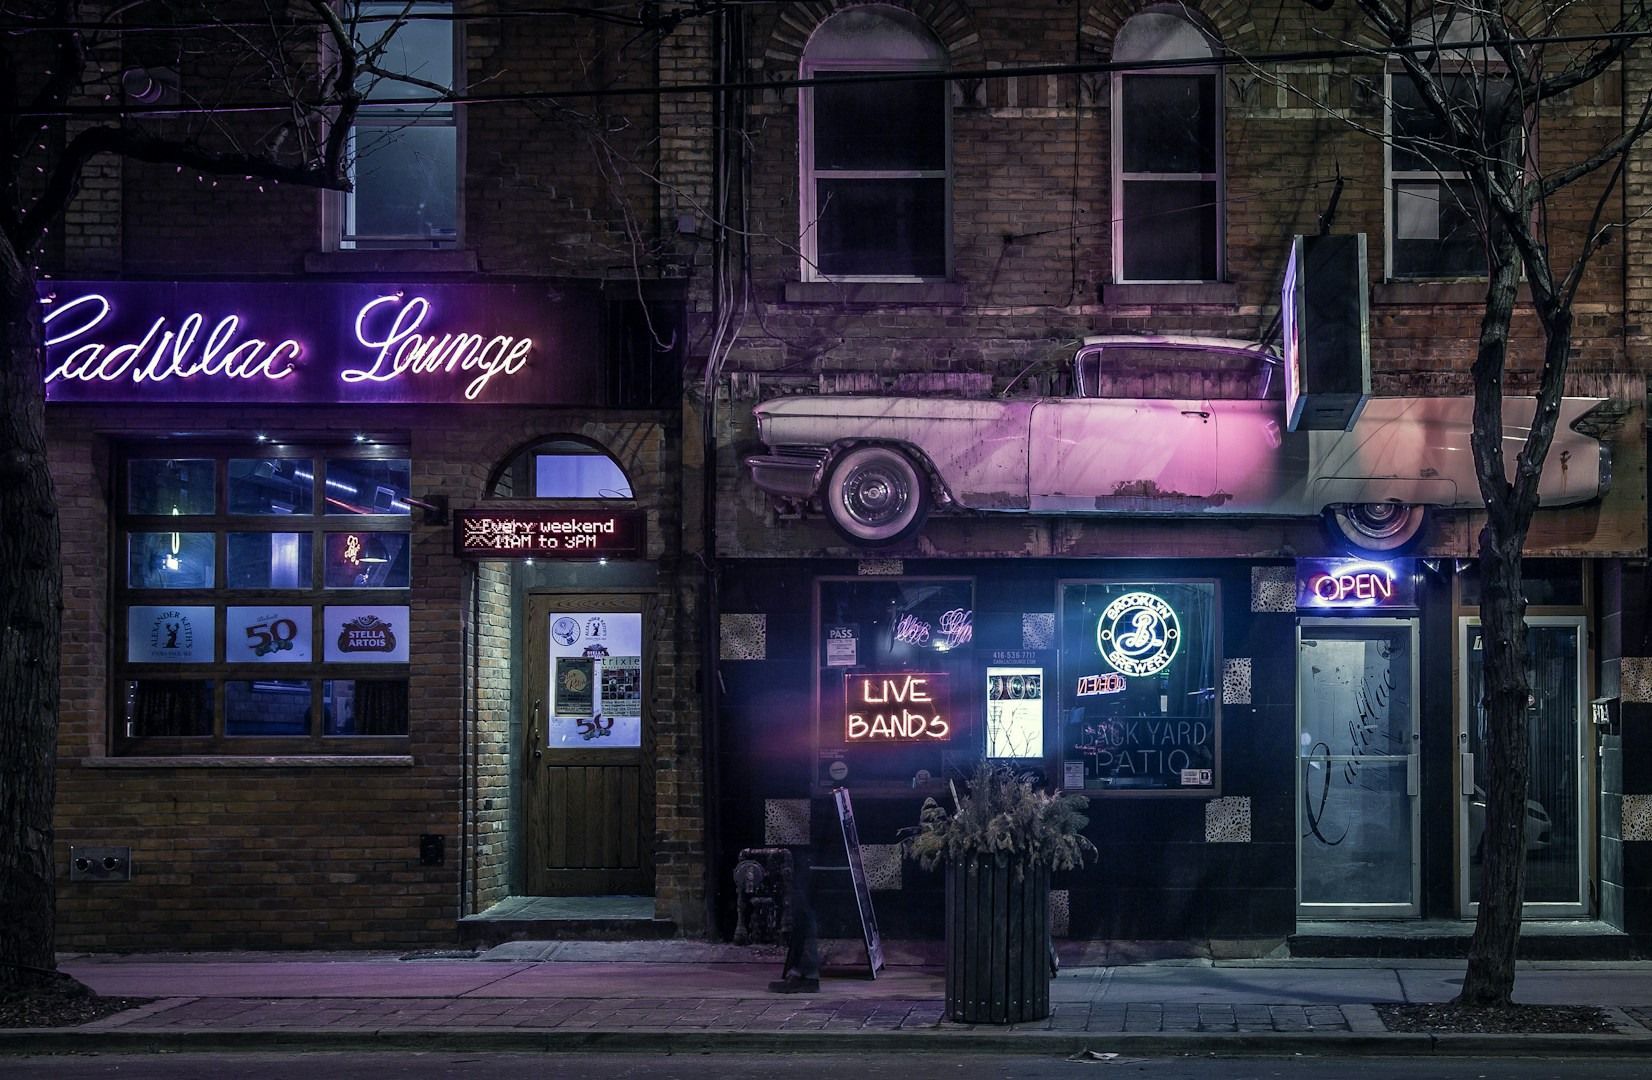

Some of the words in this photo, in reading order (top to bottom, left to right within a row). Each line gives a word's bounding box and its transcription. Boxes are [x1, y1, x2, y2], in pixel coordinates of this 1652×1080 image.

[341, 291, 534, 400] Lounge
[482, 518, 534, 534] Every
[540, 518, 615, 533] weekend
[494, 535, 532, 548] 11AM
[538, 535, 559, 548] to
[565, 535, 597, 548] 3PM
[1315, 573, 1391, 601] OPEN
[1106, 594, 1171, 621] BROOKLYN
[246, 618, 298, 649] 50
[348, 630, 386, 639] STELLA
[348, 638, 386, 648] ARTOIS
[830, 629, 853, 639] PASS
[1107, 650, 1171, 674] BREWERY
[864, 675, 932, 703] LIVE
[576, 713, 614, 735] 50
[849, 708, 950, 739] BANDS
[1144, 720, 1207, 746] YARD
[1095, 749, 1190, 775] PATIO
